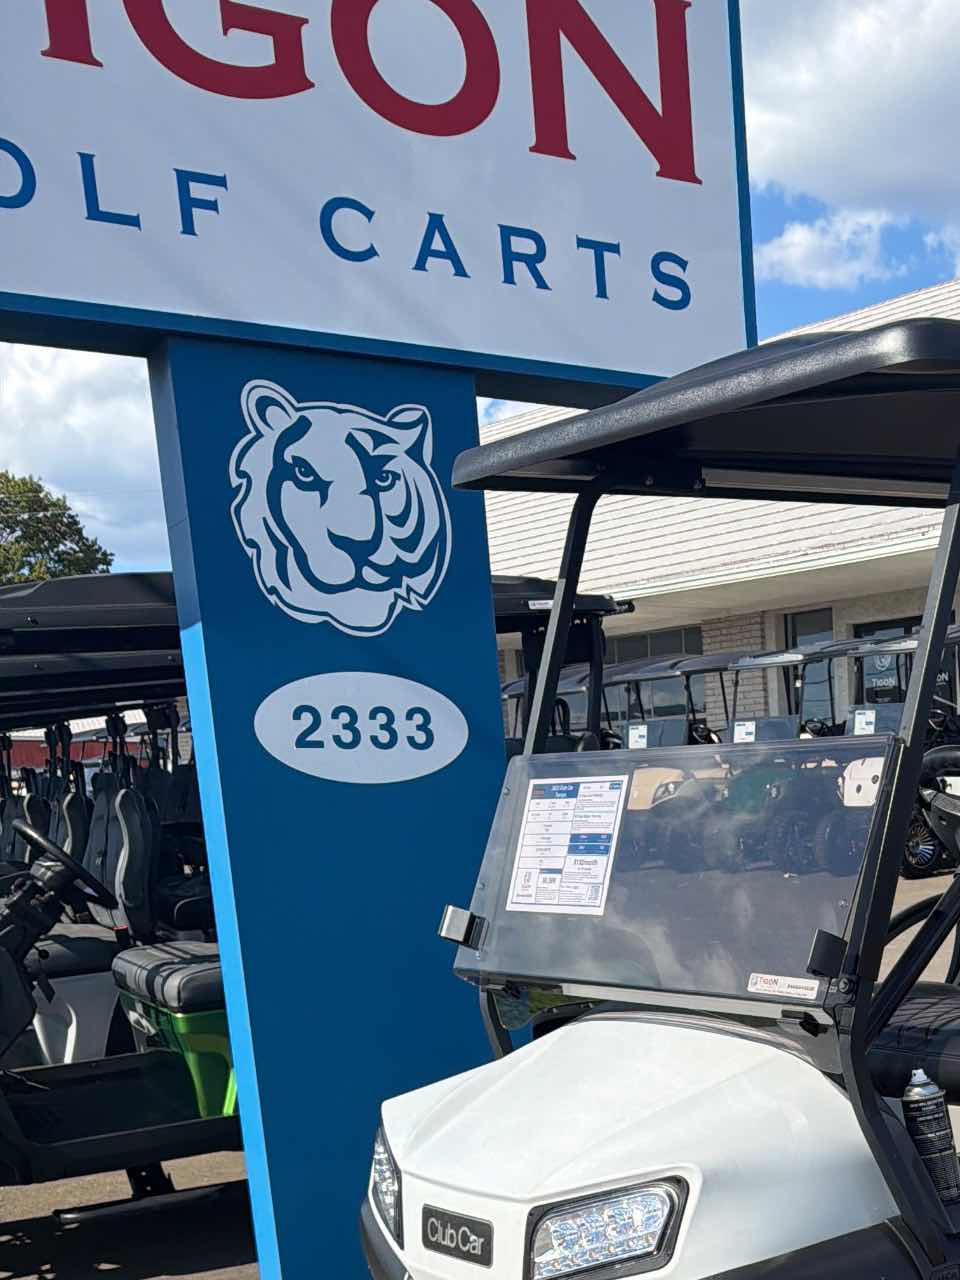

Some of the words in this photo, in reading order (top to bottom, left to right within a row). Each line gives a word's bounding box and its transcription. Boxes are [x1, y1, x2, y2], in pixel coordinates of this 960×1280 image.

[319, 196, 692, 311] CARTS
[292, 705, 435, 750] 2333
[427, 1217, 457, 1249] Club
[458, 1226, 485, 1256] Car
